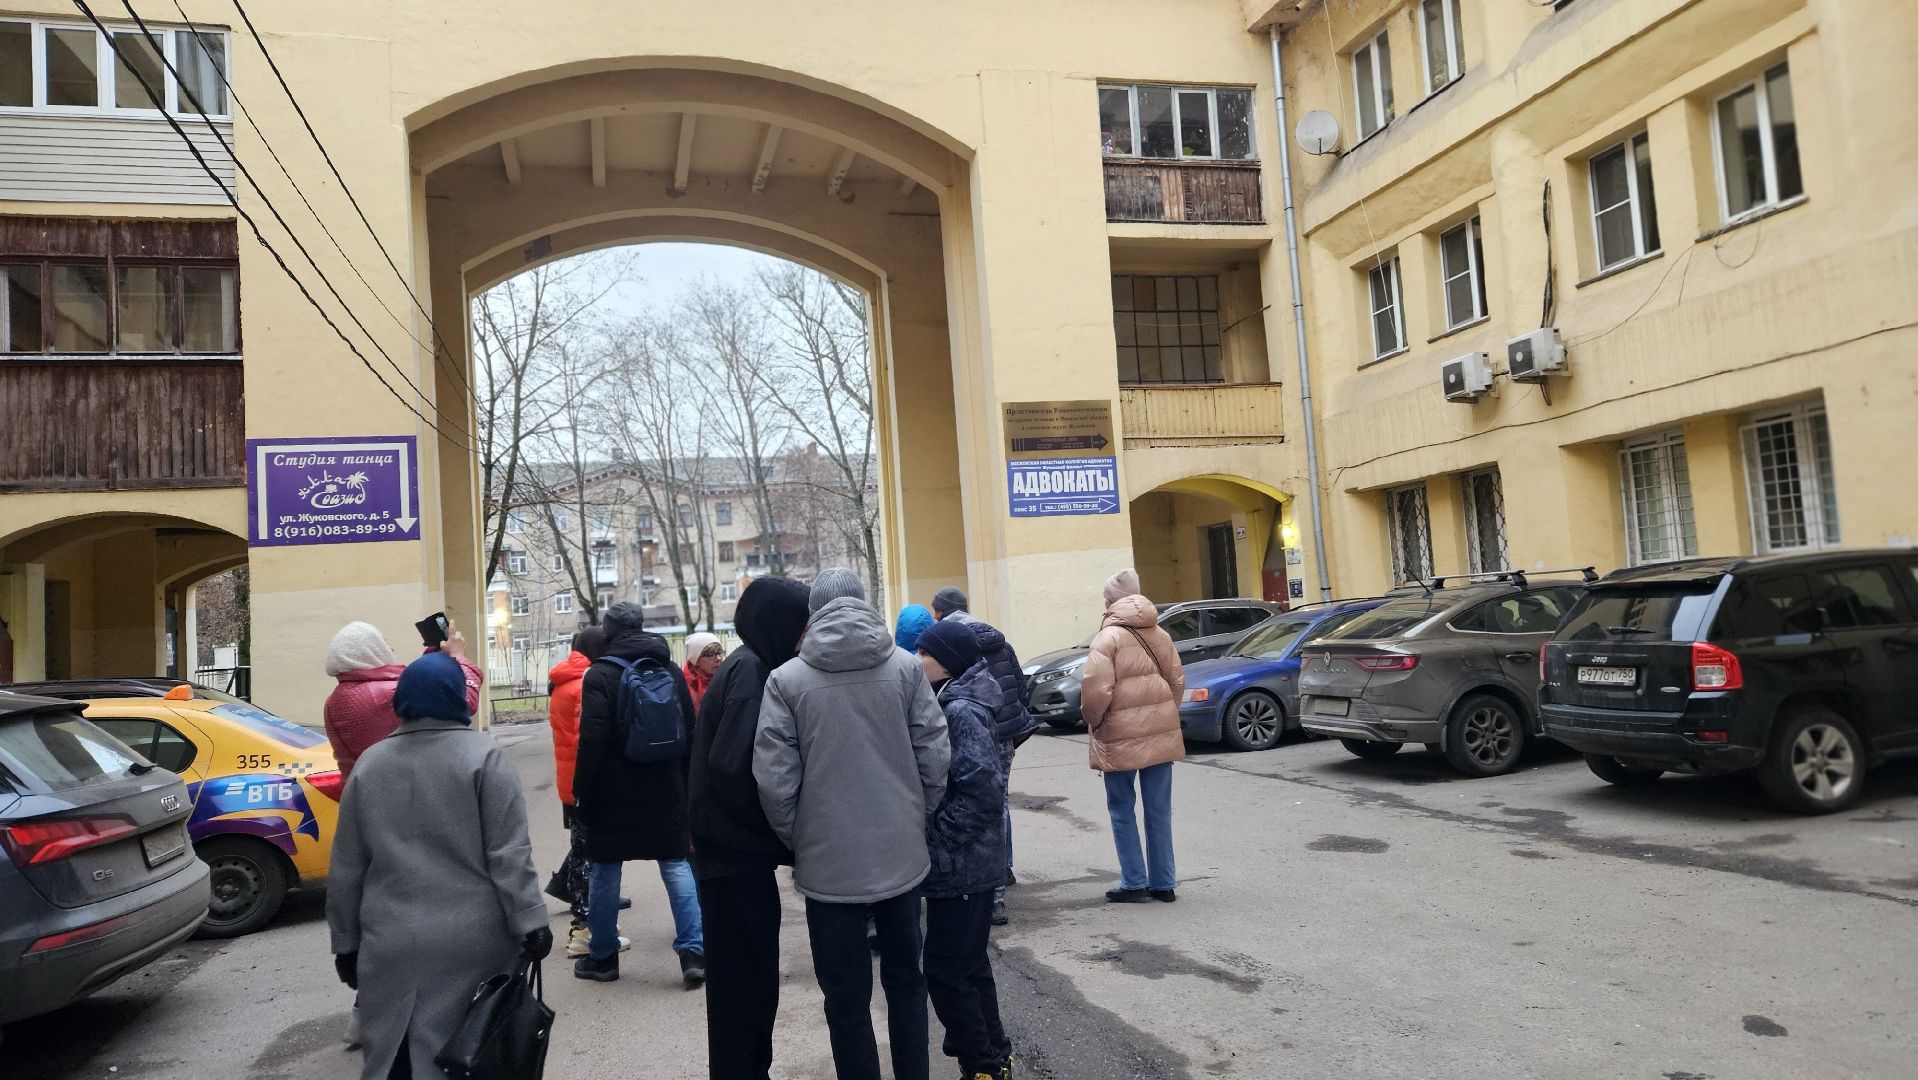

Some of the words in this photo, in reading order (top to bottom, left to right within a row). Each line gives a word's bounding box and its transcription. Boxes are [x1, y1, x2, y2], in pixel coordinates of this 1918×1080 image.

[273, 454, 336, 469] Студия
[342, 453, 393, 467] танца
[1013, 470, 1115, 497] АДВОКАТЫ
[280, 515, 296, 525] ул.
[298, 512, 368, 523] Жуковского,
[369, 513, 380, 521] д.
[382, 511, 389, 519] 5
[274, 523, 396, 538] 8(916)083-89-99
[1591, 655, 1608, 664] Jeep
[1617, 668, 1633, 679] 750
[236, 754, 271, 769] 355
[248, 782, 293, 803] ВТБ
[93, 869, 114, 881] Q5
